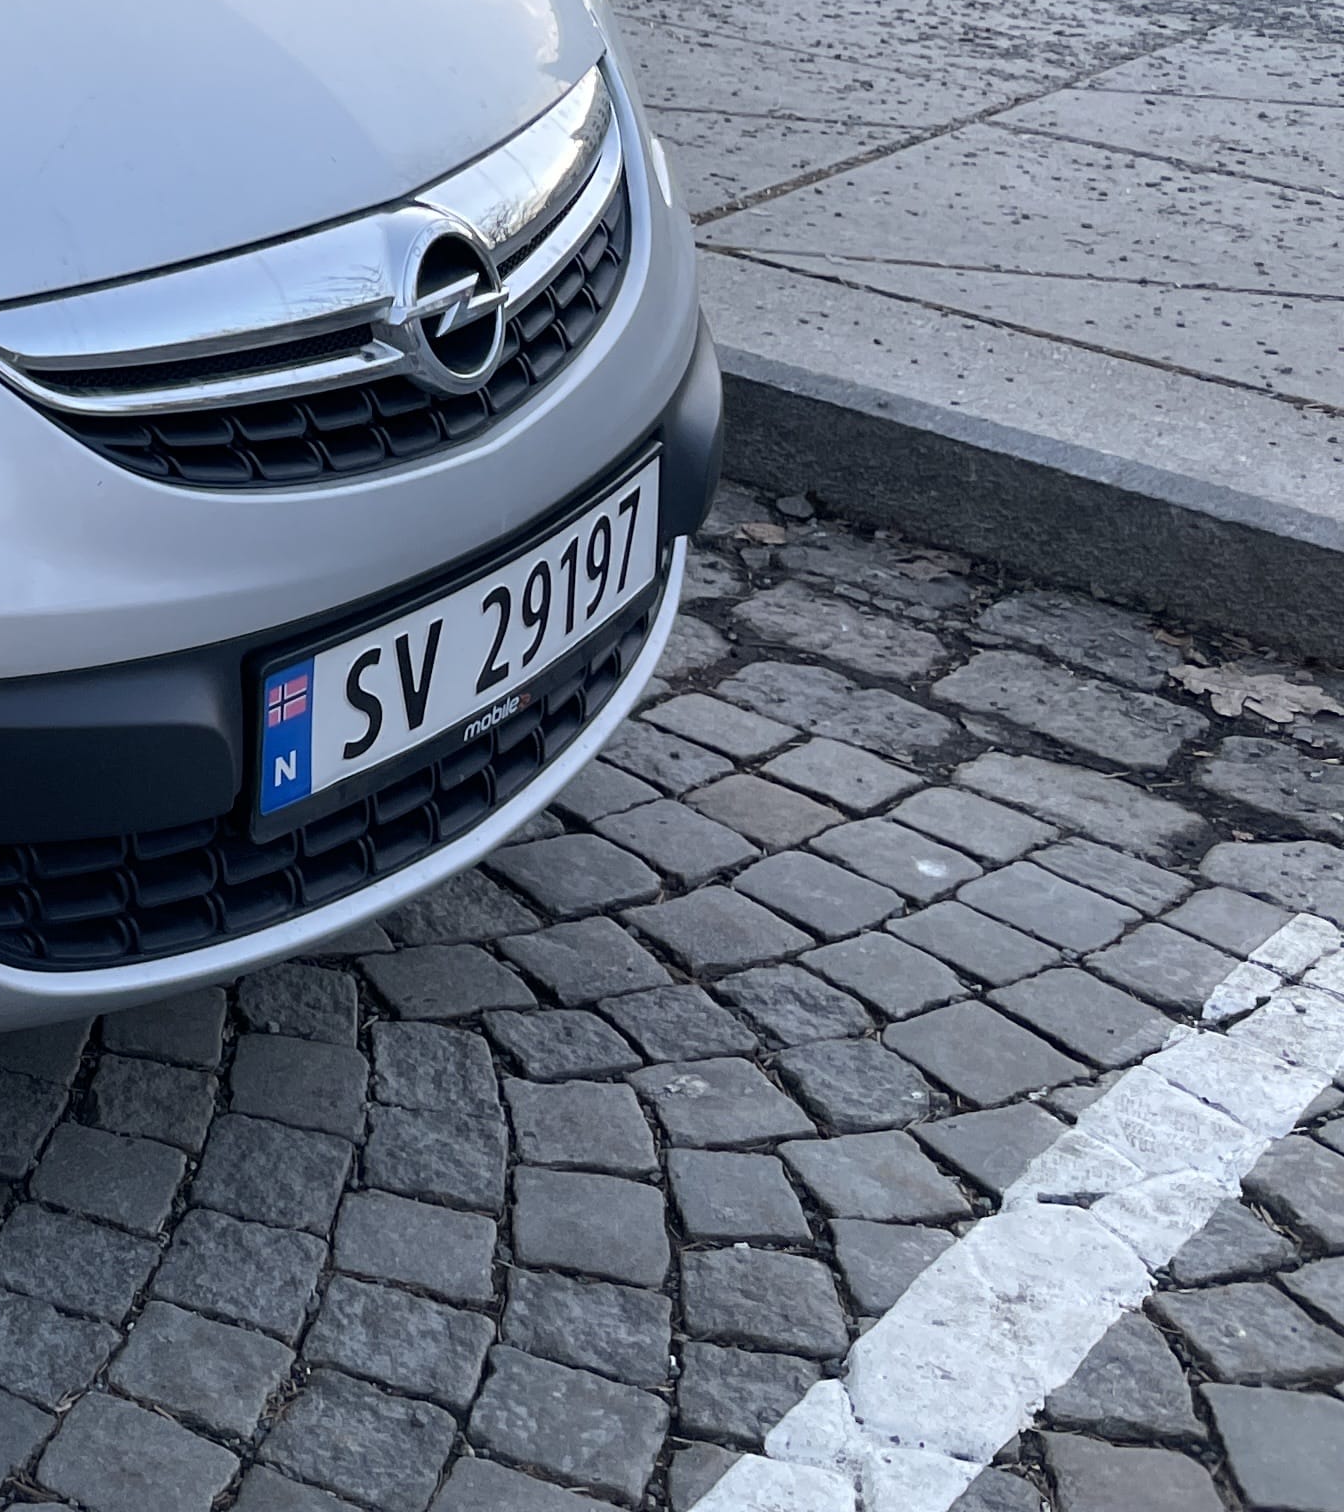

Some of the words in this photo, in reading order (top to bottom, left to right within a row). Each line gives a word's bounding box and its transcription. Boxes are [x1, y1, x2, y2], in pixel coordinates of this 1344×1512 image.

[342, 618, 444, 761] SV
[475, 485, 642, 695] 29197
[274, 750, 297, 787] N
